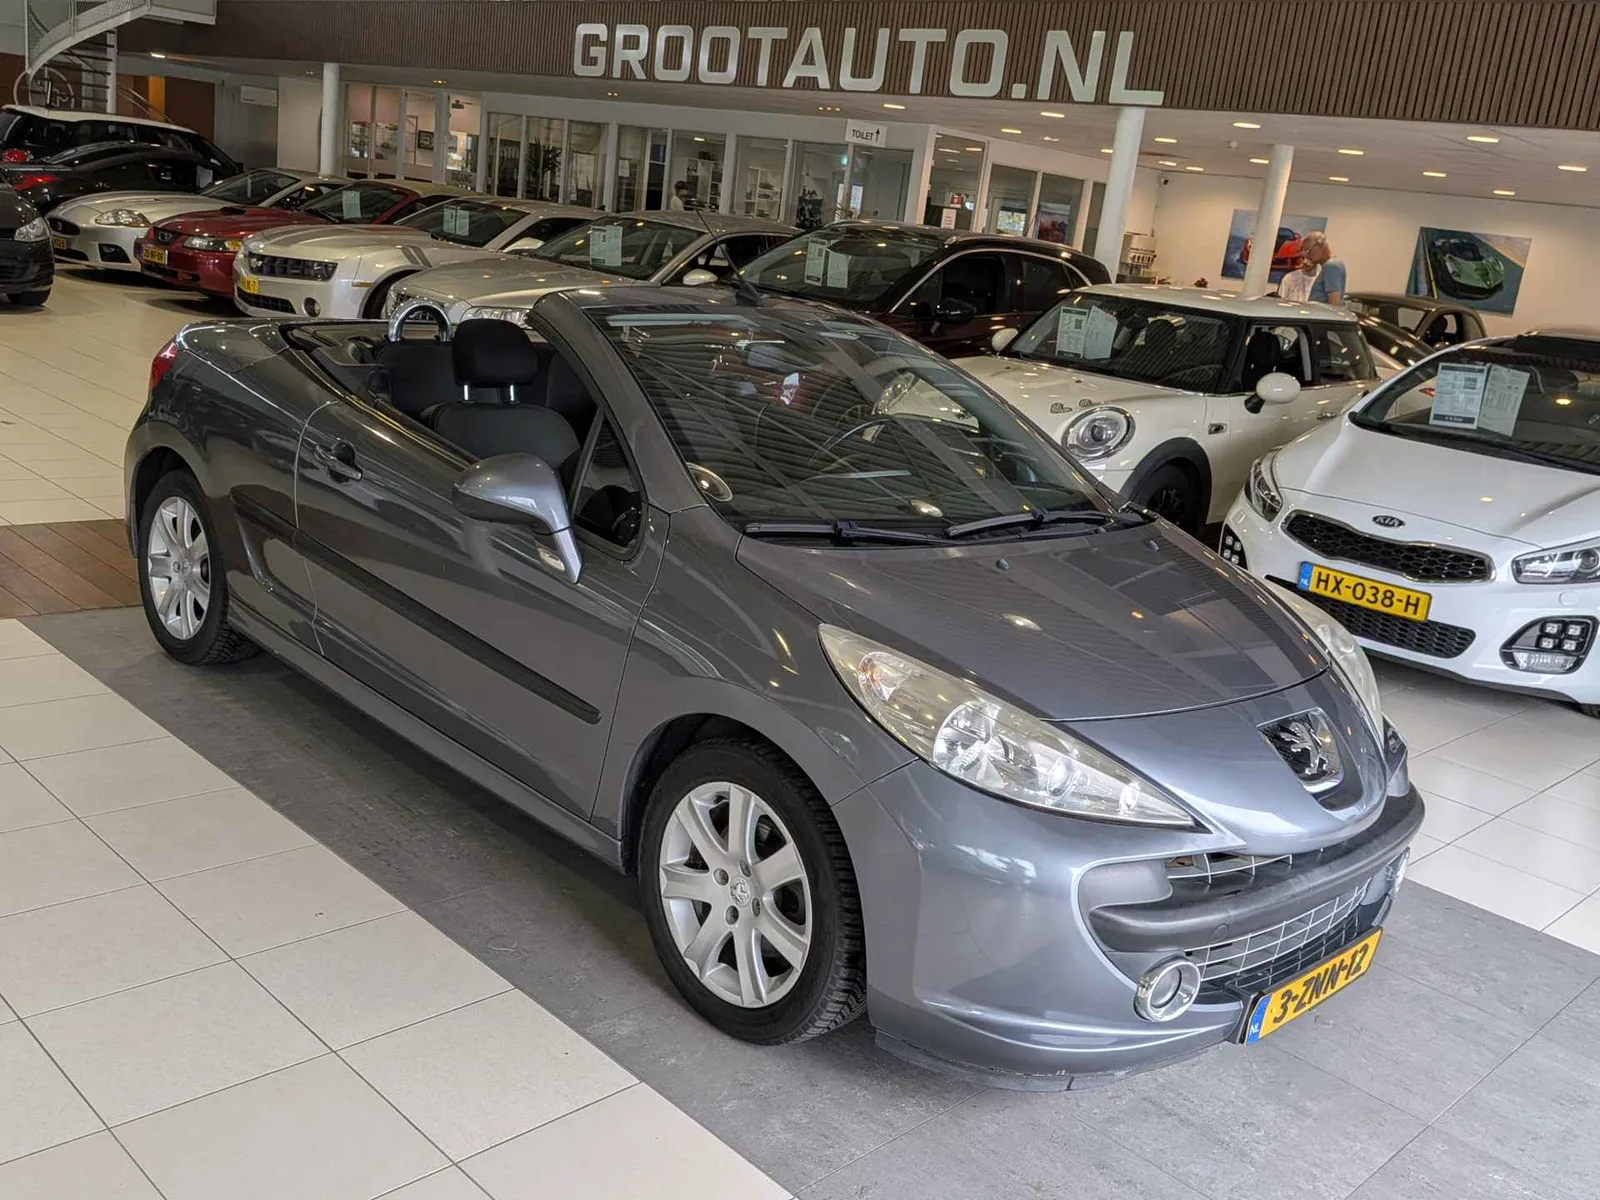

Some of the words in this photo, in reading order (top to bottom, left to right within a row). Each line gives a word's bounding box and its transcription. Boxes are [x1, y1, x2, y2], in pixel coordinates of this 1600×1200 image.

[573, 23, 1164, 106] GROOTAUTO.NL
[851, 128, 874, 141] TOILET
[1315, 571, 1420, 615] HX-038-H
[1272, 943, 1370, 1024] 3-ZNN-12
